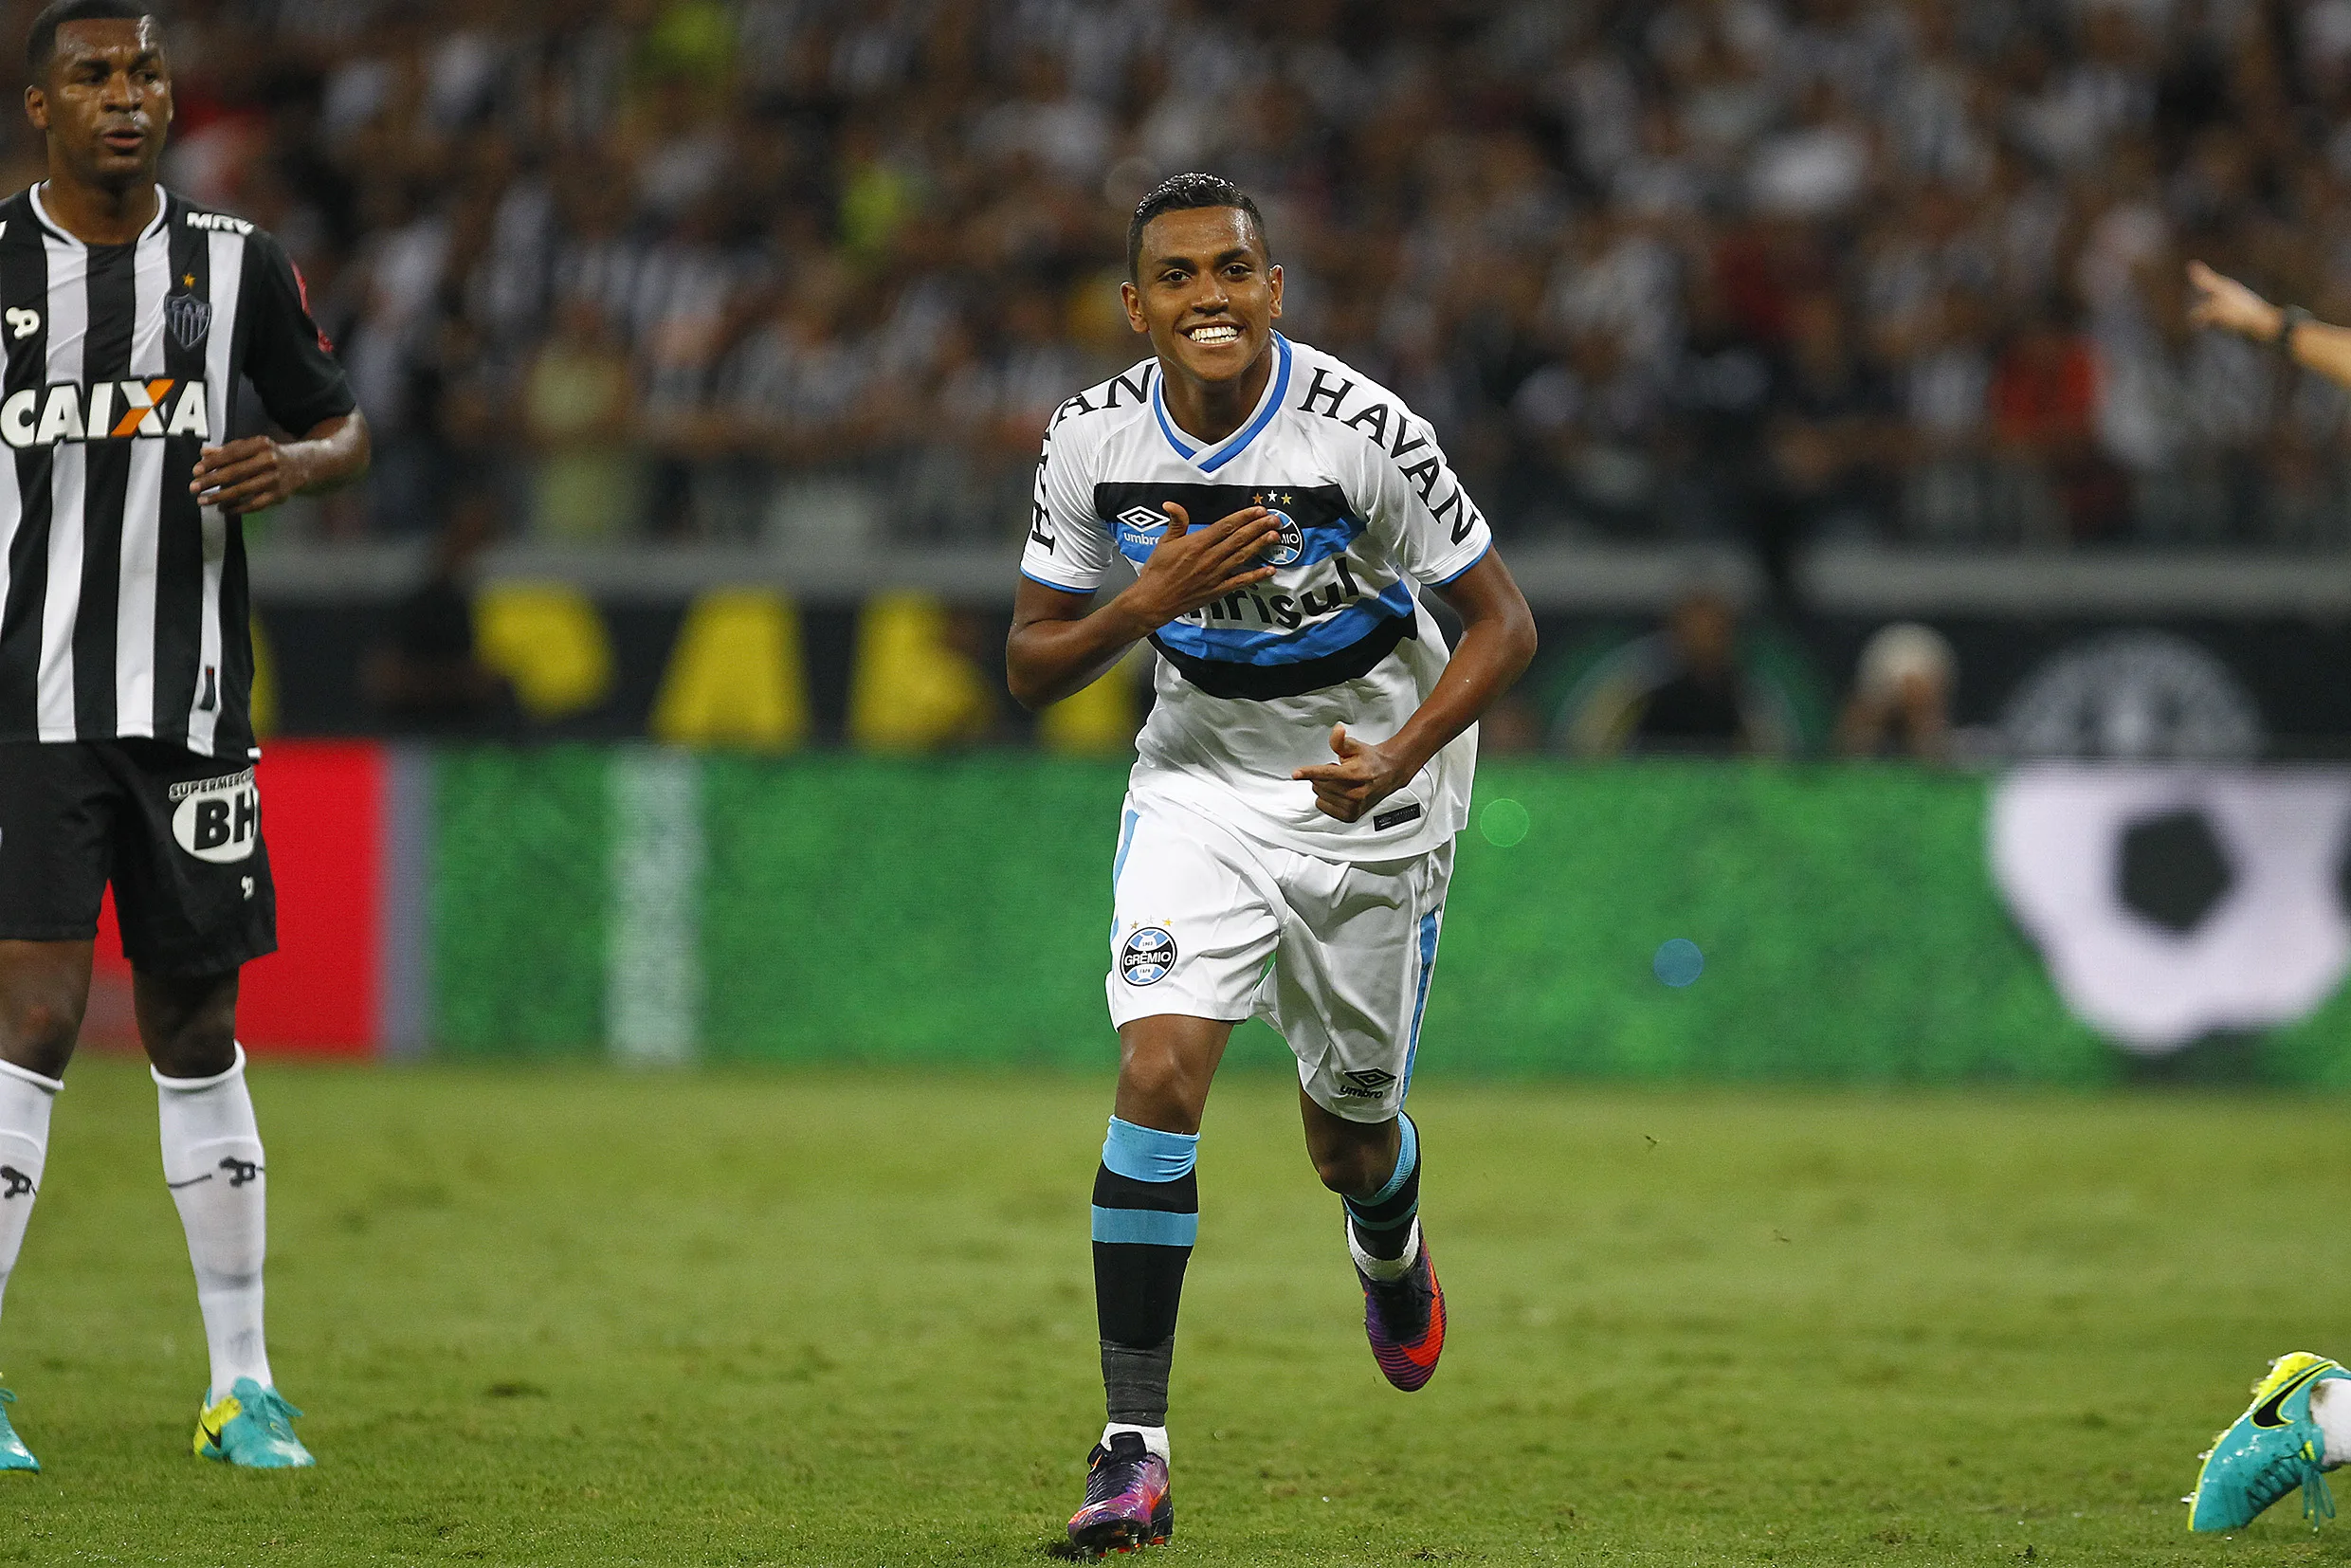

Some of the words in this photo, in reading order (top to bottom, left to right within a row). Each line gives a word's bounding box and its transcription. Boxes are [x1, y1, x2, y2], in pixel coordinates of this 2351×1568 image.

[0, 379, 210, 447] CAIXA
[1297, 366, 1481, 547] HAVAN
[193, 788, 255, 851] BH
[1124, 950, 1172, 967] GRÊMIO
[1340, 1085, 1384, 1099] umbro
